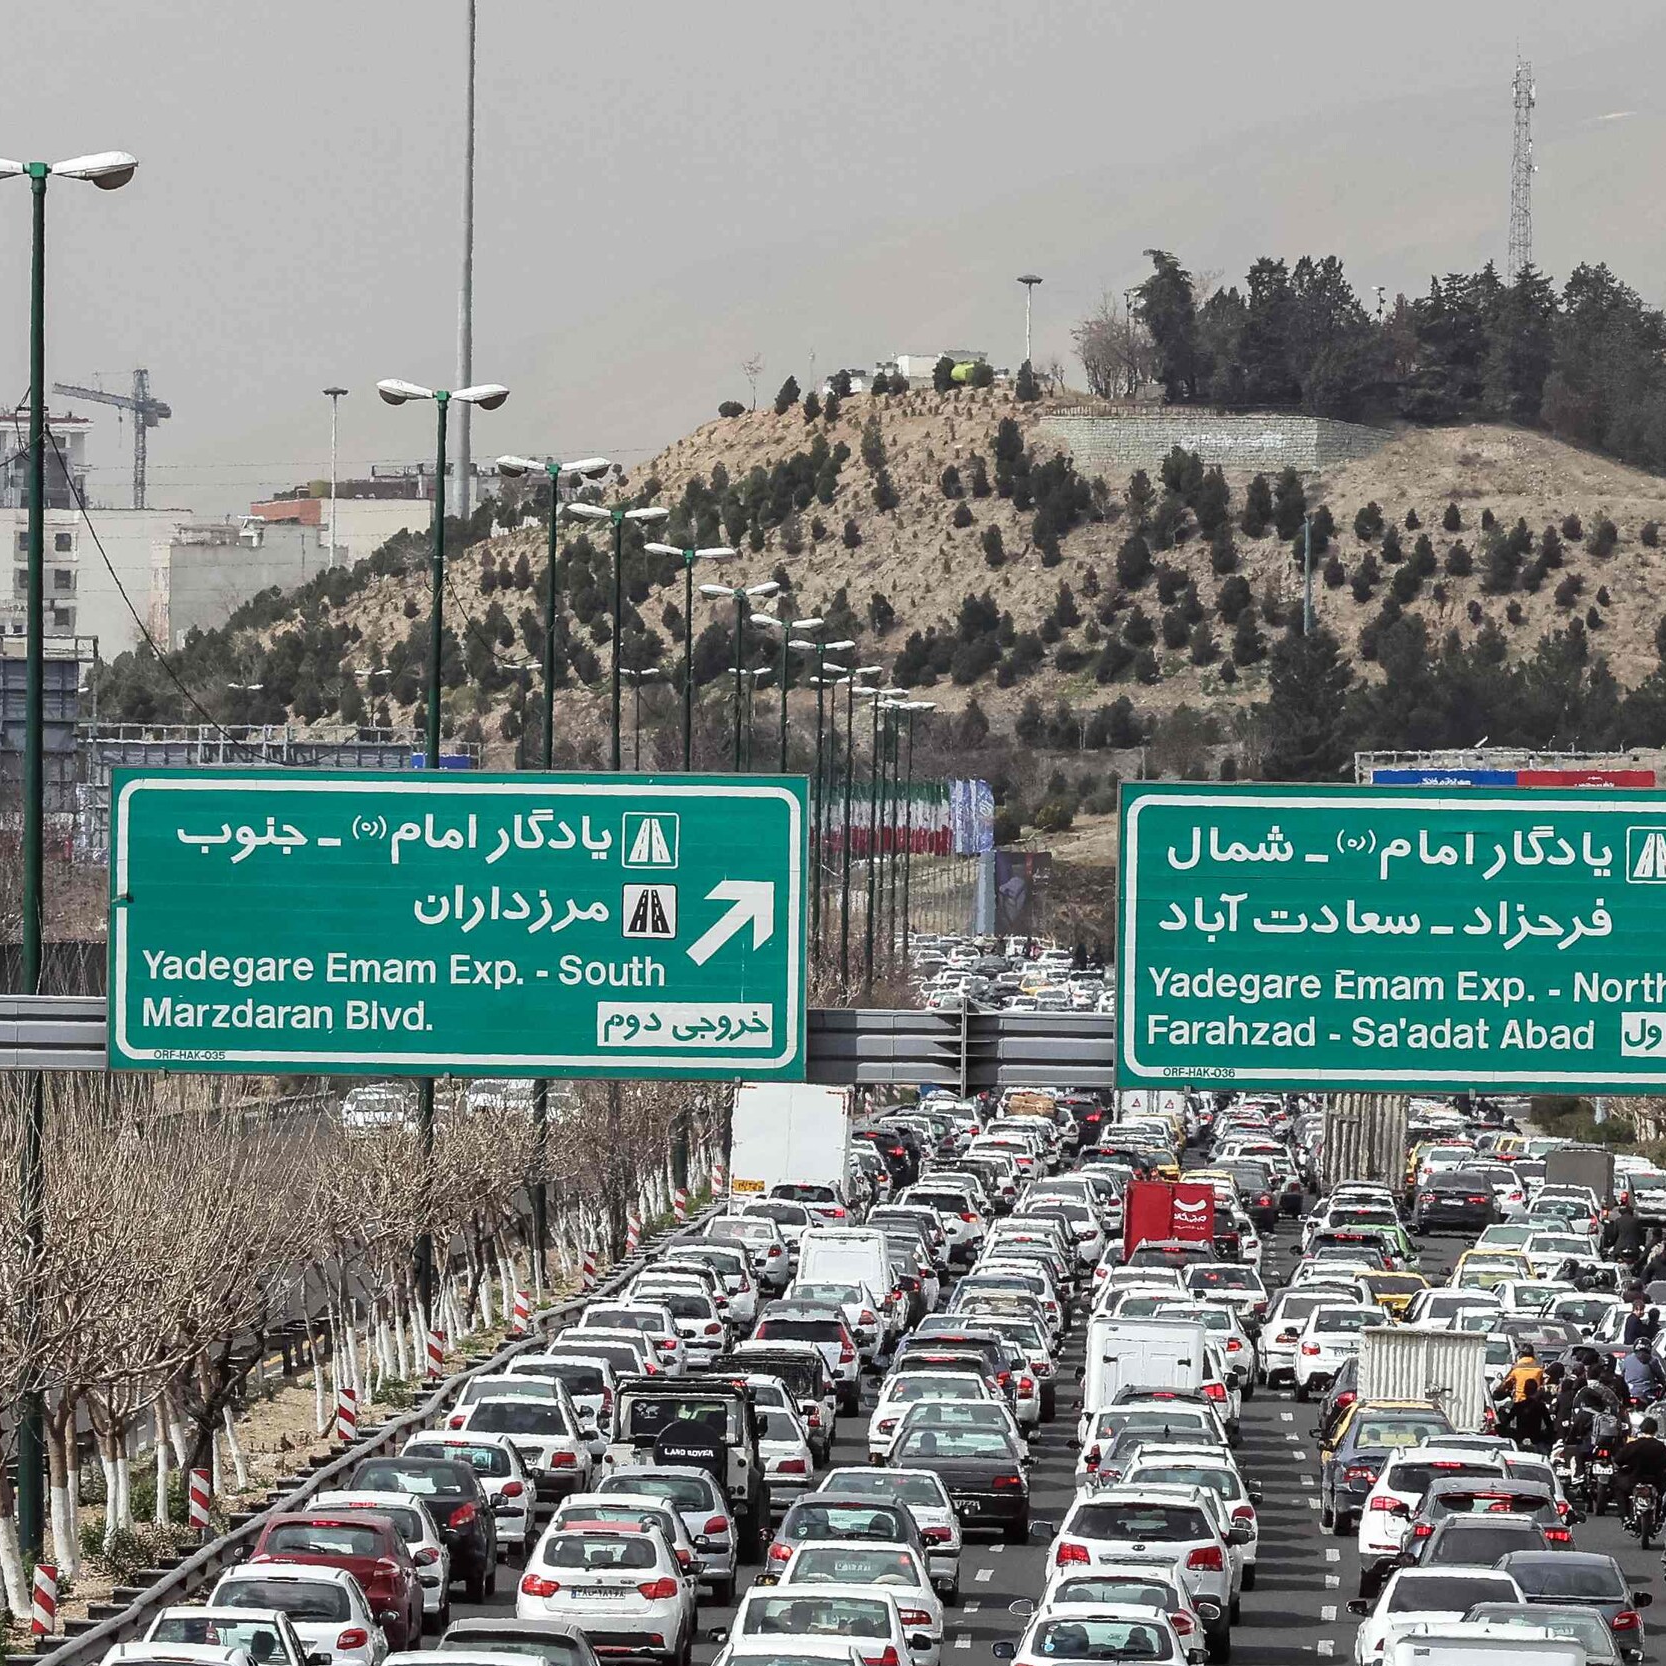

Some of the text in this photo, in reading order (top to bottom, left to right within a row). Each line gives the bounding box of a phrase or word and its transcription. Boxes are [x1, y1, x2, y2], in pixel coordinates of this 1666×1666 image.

[178, 819, 308, 863] جنوب
[486, 809, 612, 863] یادگار
[1168, 826, 1293, 869] شمال
[1483, 826, 1612, 880] یادگار
[415, 885, 609, 933] مرزداران
[1159, 893, 1247, 942] آباد
[1254, 900, 1420, 934] سعادت
[1463, 898, 1612, 950] فرحزاد
[143, 950, 313, 987] Yadegare
[327, 953, 436, 983] Emam
[451, 955, 523, 989] Exp.
[559, 955, 664, 986] South
[1149, 967, 1321, 1003] Yadegare
[1335, 970, 1443, 1000] Emam
[1458, 971, 1534, 1007] Exp.
[143, 996, 432, 1033] Marzdaran Blvd.
[604, 1012, 768, 1042] خروجی دوم
[1148, 1015, 1315, 1046] Farahzad
[1353, 1017, 1489, 1049] Sa'adat
[1500, 1019, 1594, 1049] Abad
[664, 1448, 686, 1456] LAND
